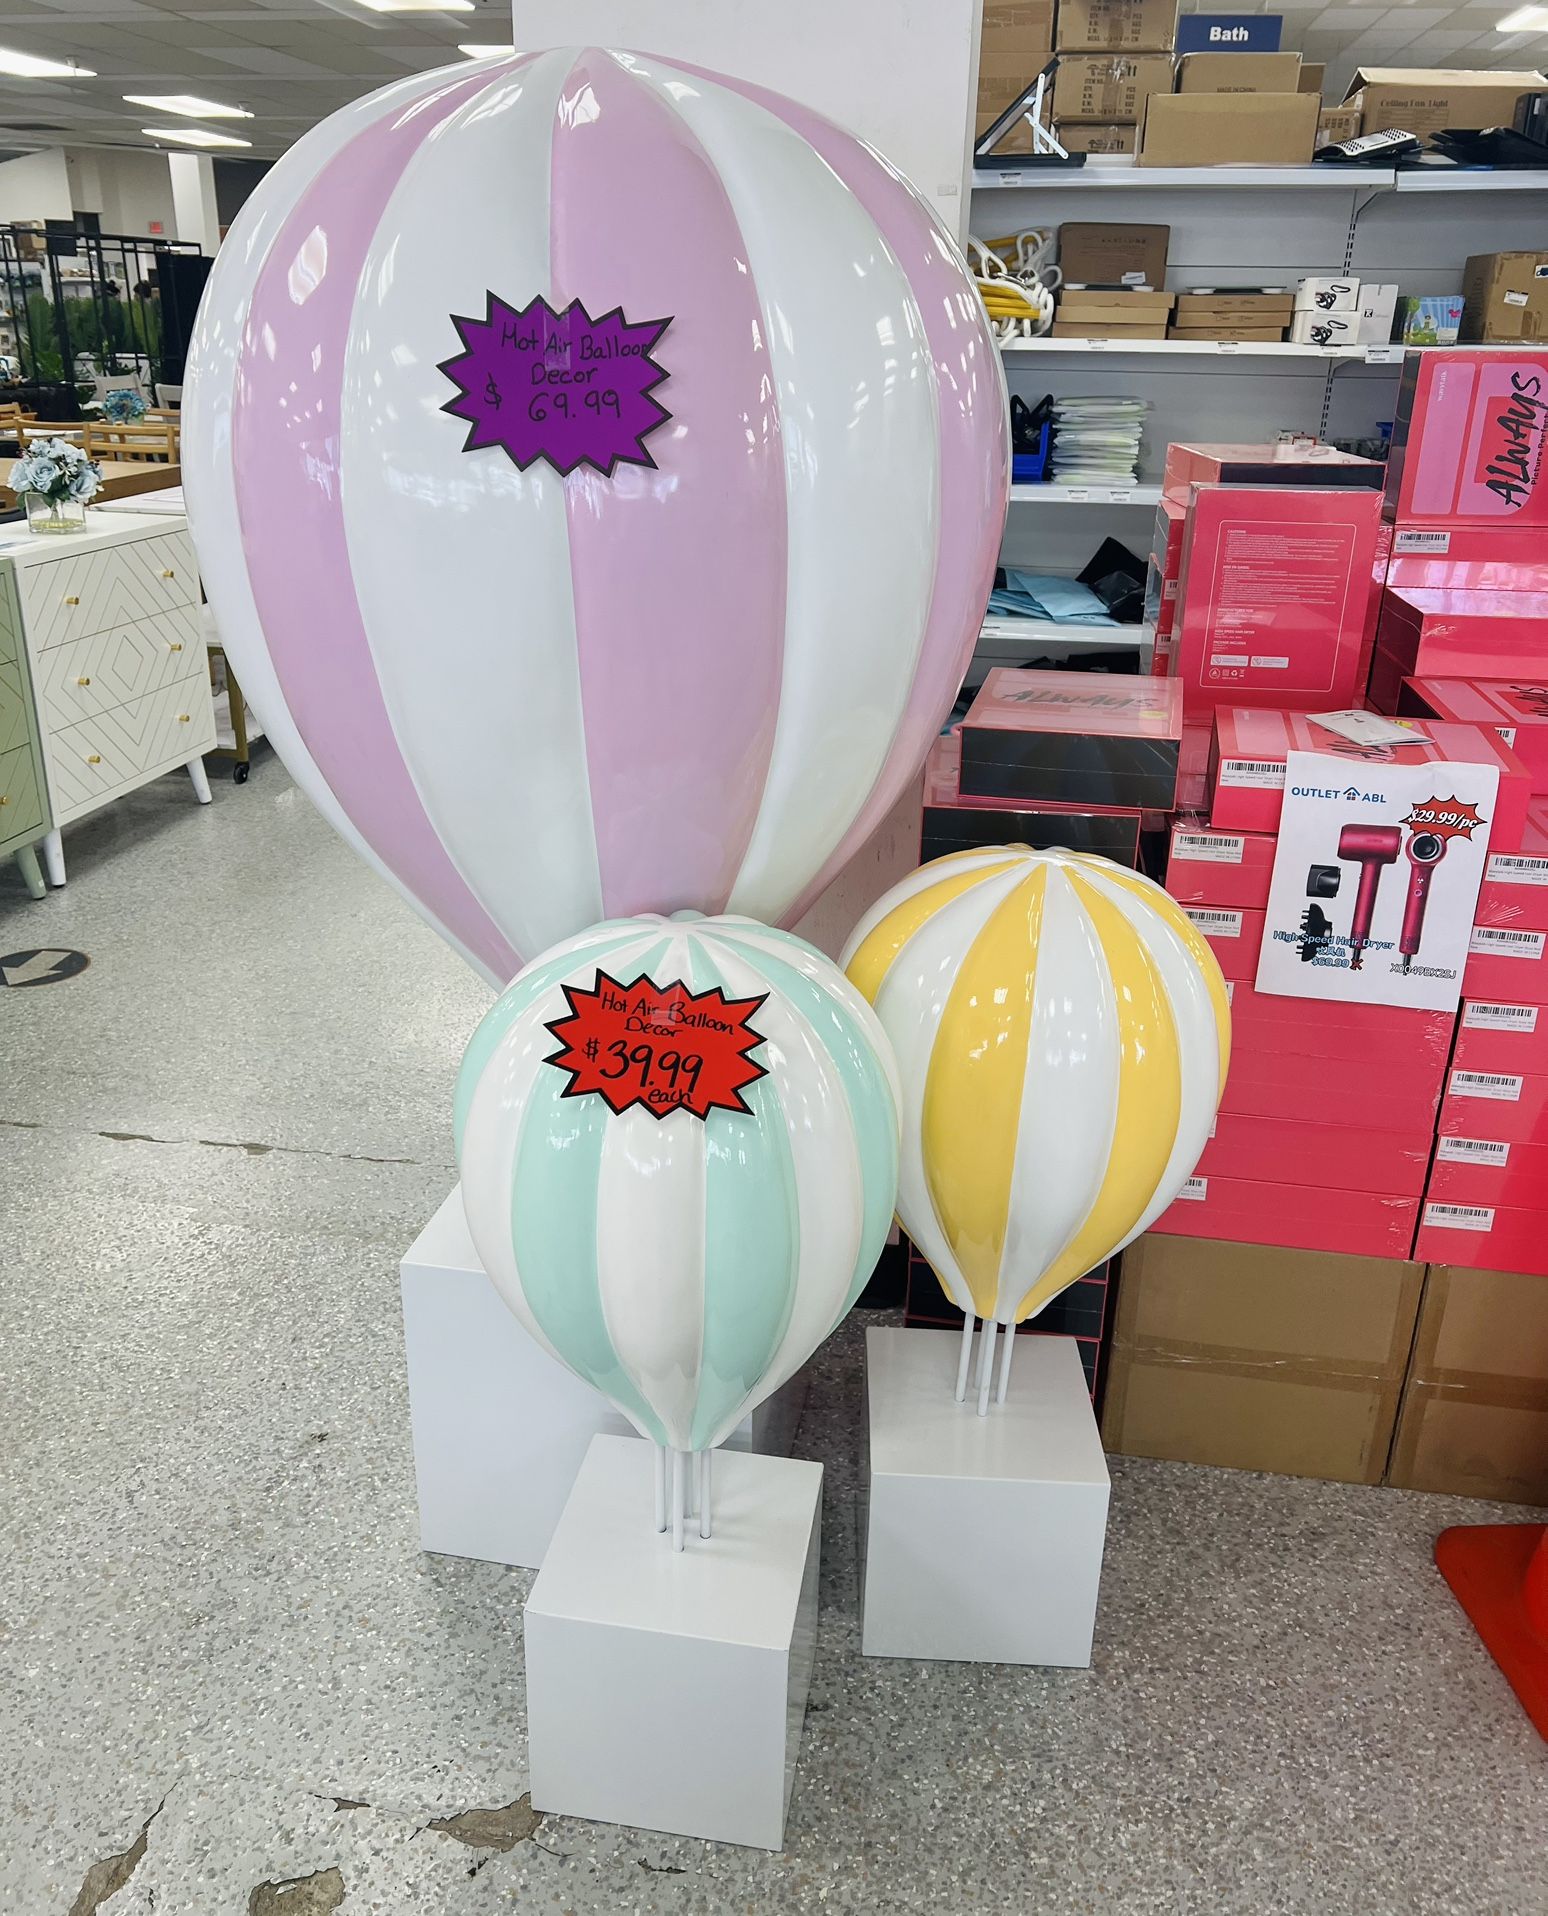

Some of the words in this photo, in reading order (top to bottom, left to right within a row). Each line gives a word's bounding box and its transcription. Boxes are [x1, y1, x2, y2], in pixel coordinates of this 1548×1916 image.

[1208, 26, 1249, 41] Bath
[500, 321, 539, 351] Hot
[543, 331, 572, 356] Air
[530, 362, 598, 386] Decor
[528, 389, 621, 422] 69.99
[1291, 786, 1341, 800] OUTLET
[1361, 792, 1387, 804] ABL
[1407, 808, 1478, 830] $29.99/pc
[1273, 930, 1300, 944] High
[1300, 933, 1335, 945] Speed
[1335, 935, 1359, 947] Hair
[1362, 939, 1396, 950] Dryer
[1311, 956, 1351, 969] $69.99
[600, 991, 629, 1013] Hot
[632, 998, 660, 1017] Air
[668, 1001, 734, 1035] Balloon
[624, 1016, 684, 1038] Decor
[647, 1087, 694, 1105] each
